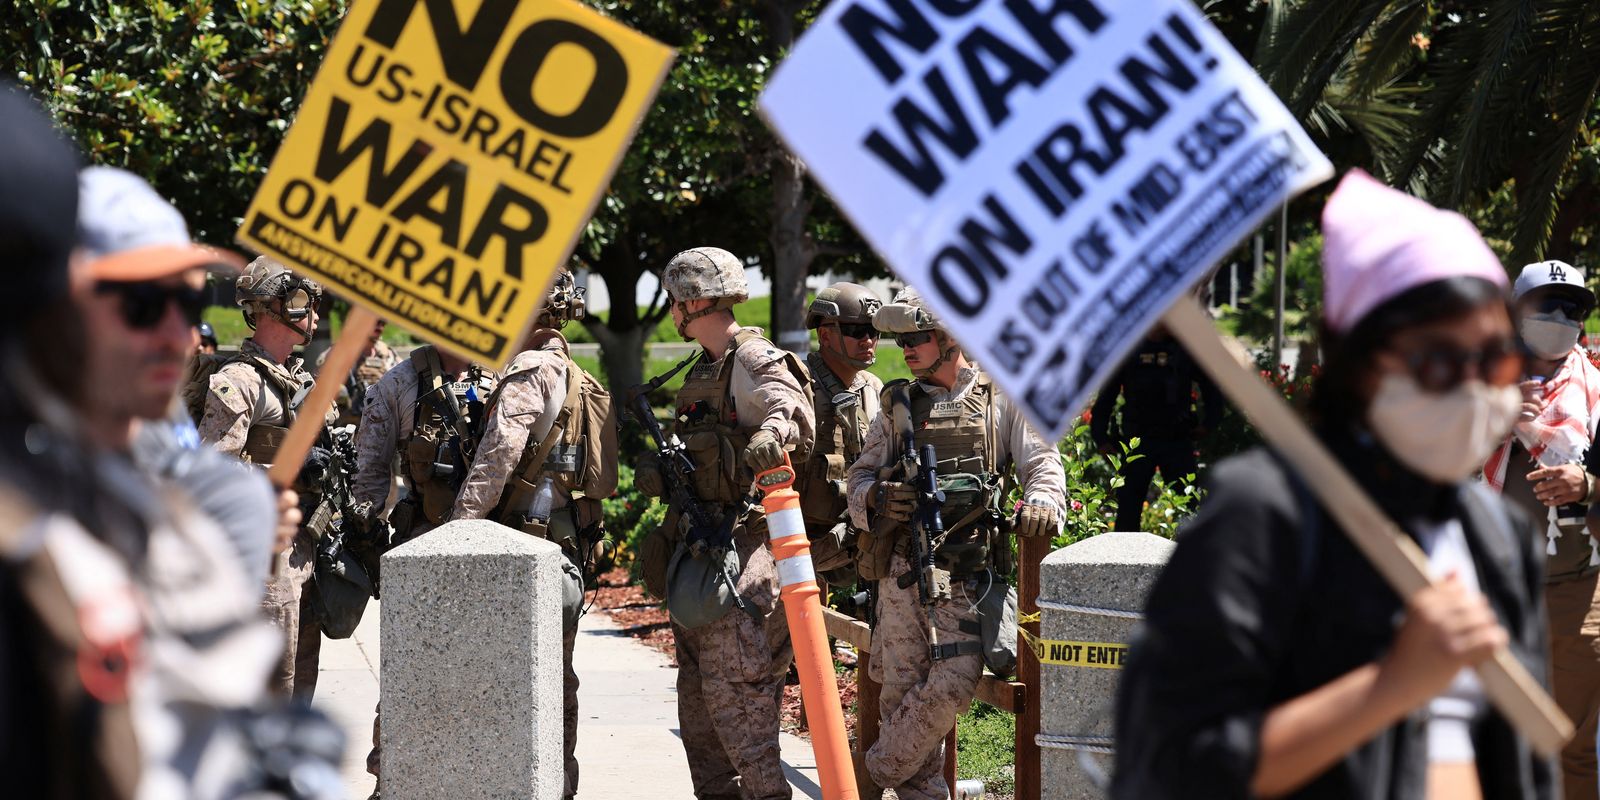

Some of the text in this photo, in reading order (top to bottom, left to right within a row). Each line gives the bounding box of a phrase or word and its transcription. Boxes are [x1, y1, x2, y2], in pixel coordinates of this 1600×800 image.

[364, 0, 629, 139] NO
[837, 0, 988, 87] N
[314, 94, 549, 281] WAR
[345, 43, 574, 196] US-ISRAEL
[928, 192, 1033, 318] ON
[1014, 13, 1219, 219] IRAN!
[256, 221, 498, 352] ANSWERCOALITION.ORG
[278, 179, 520, 324] ON IRAN!
[987, 88, 1260, 377] US OUT OF MID-EAST
[1548, 262, 1567, 282] LA
[931, 402, 962, 411] USMC
[1050, 644, 1083, 663] NOT
[1086, 645, 1129, 666] ENTE
